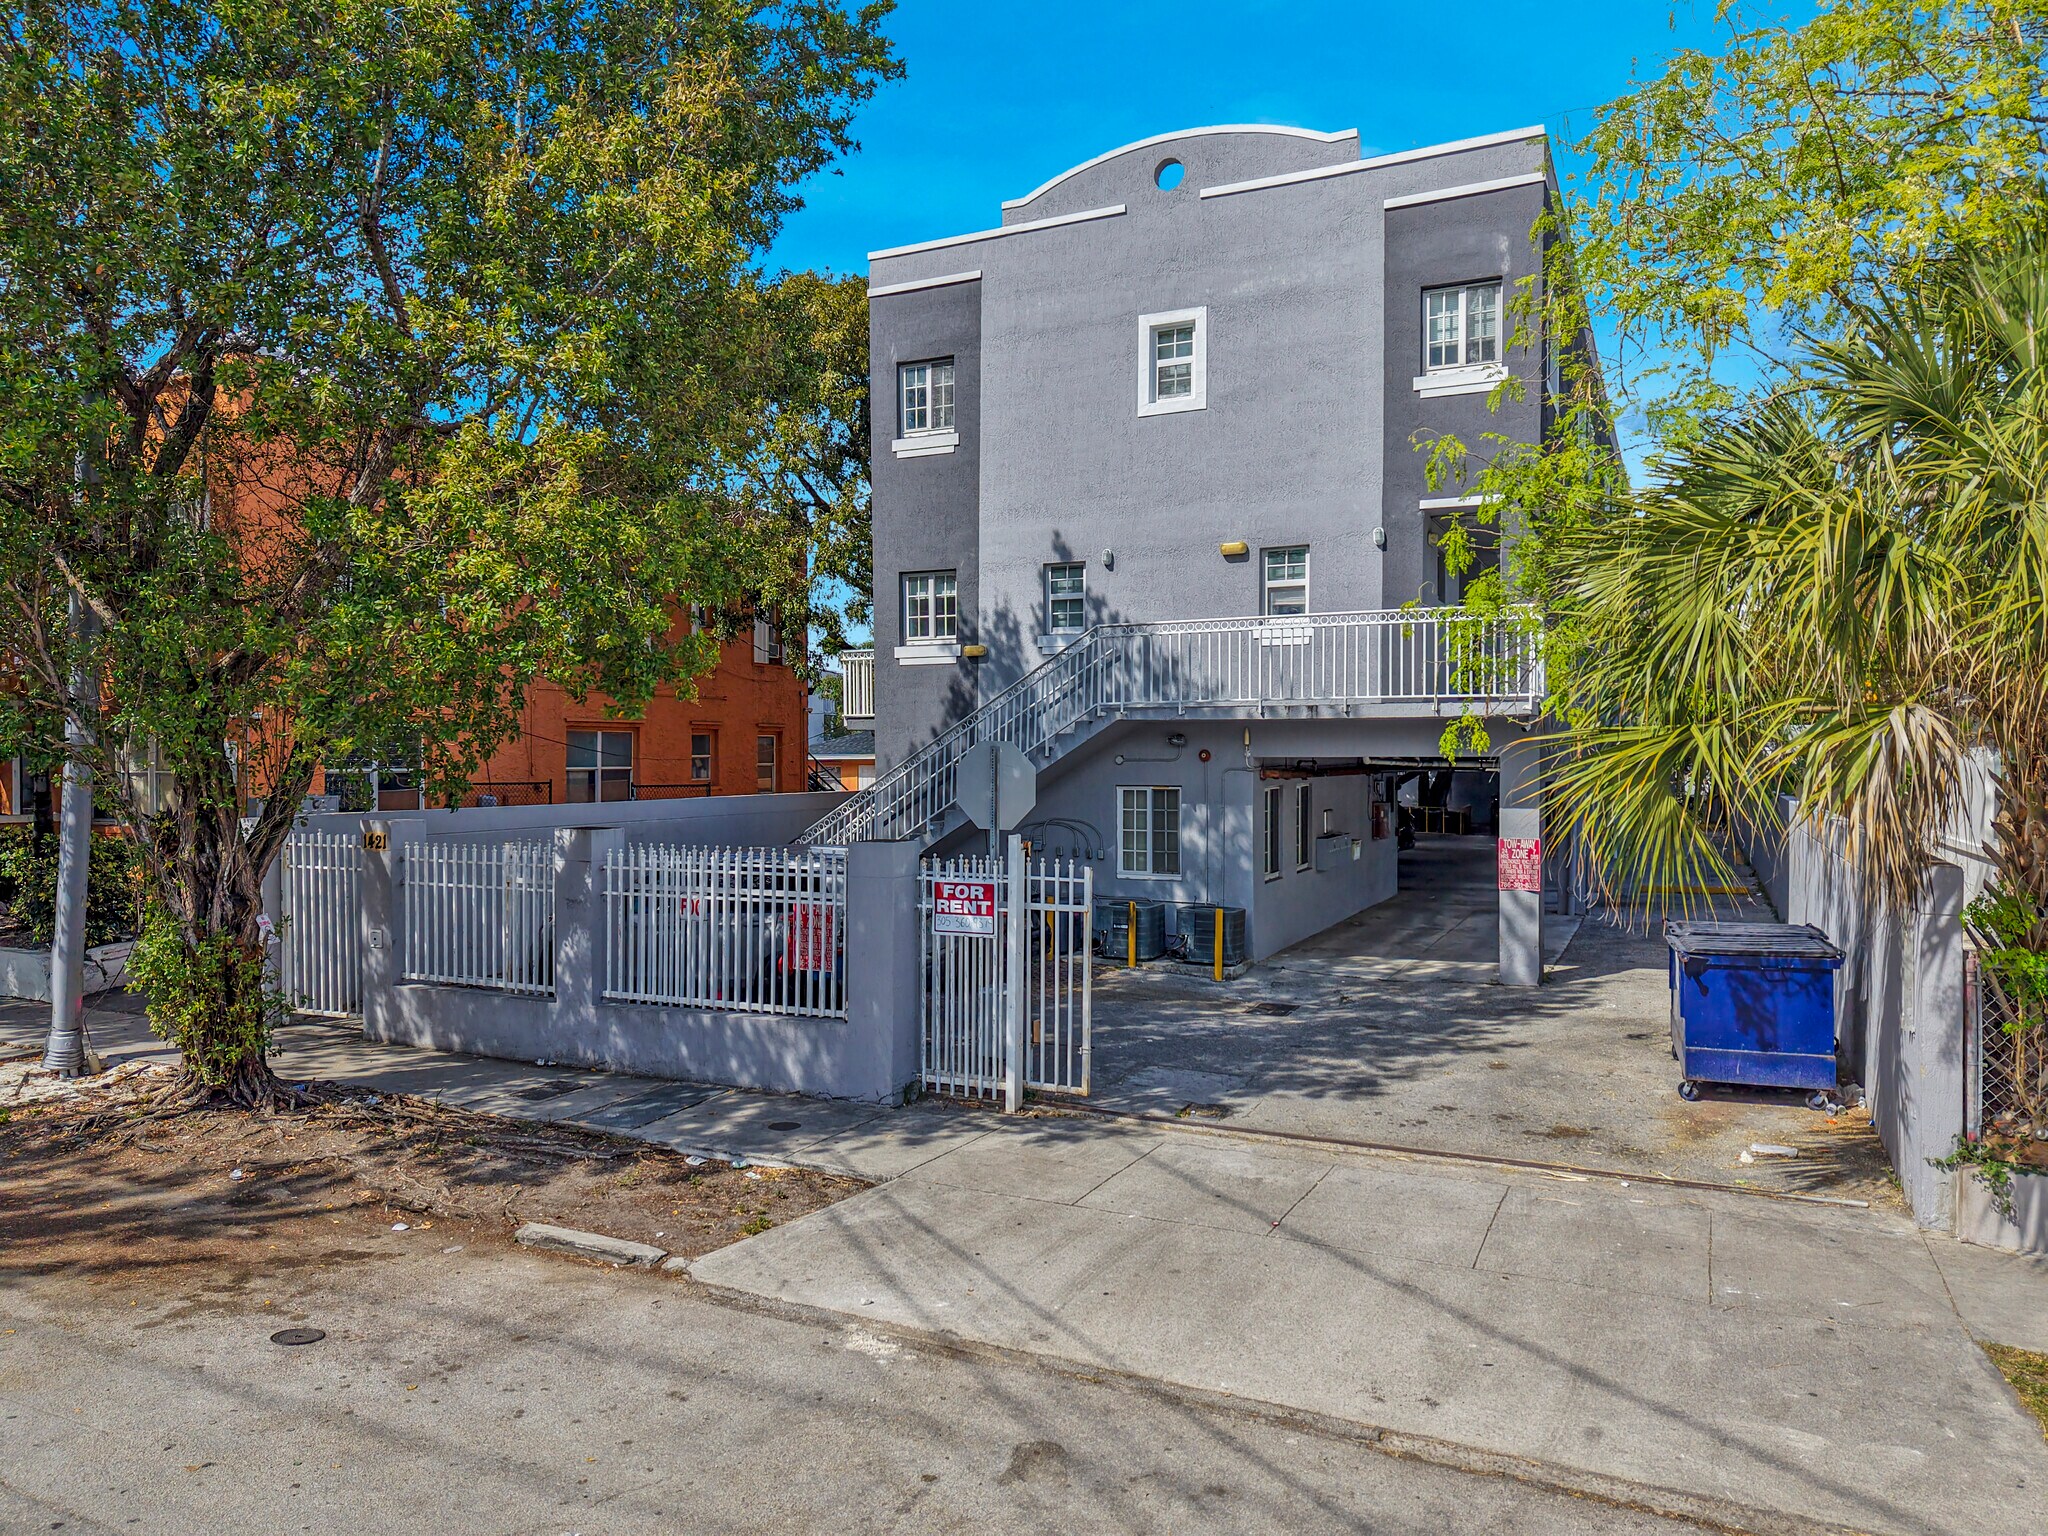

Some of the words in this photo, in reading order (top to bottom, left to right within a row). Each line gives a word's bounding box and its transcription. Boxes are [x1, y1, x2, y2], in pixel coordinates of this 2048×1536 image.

[363, 833, 387, 850] 1421
[1504, 839, 1535, 849] TOW-AWAY
[1511, 849, 1529, 859] ZONE
[943, 885, 984, 899] FOR
[936, 899, 991, 914] RENT
[936, 915, 951, 927] 305
